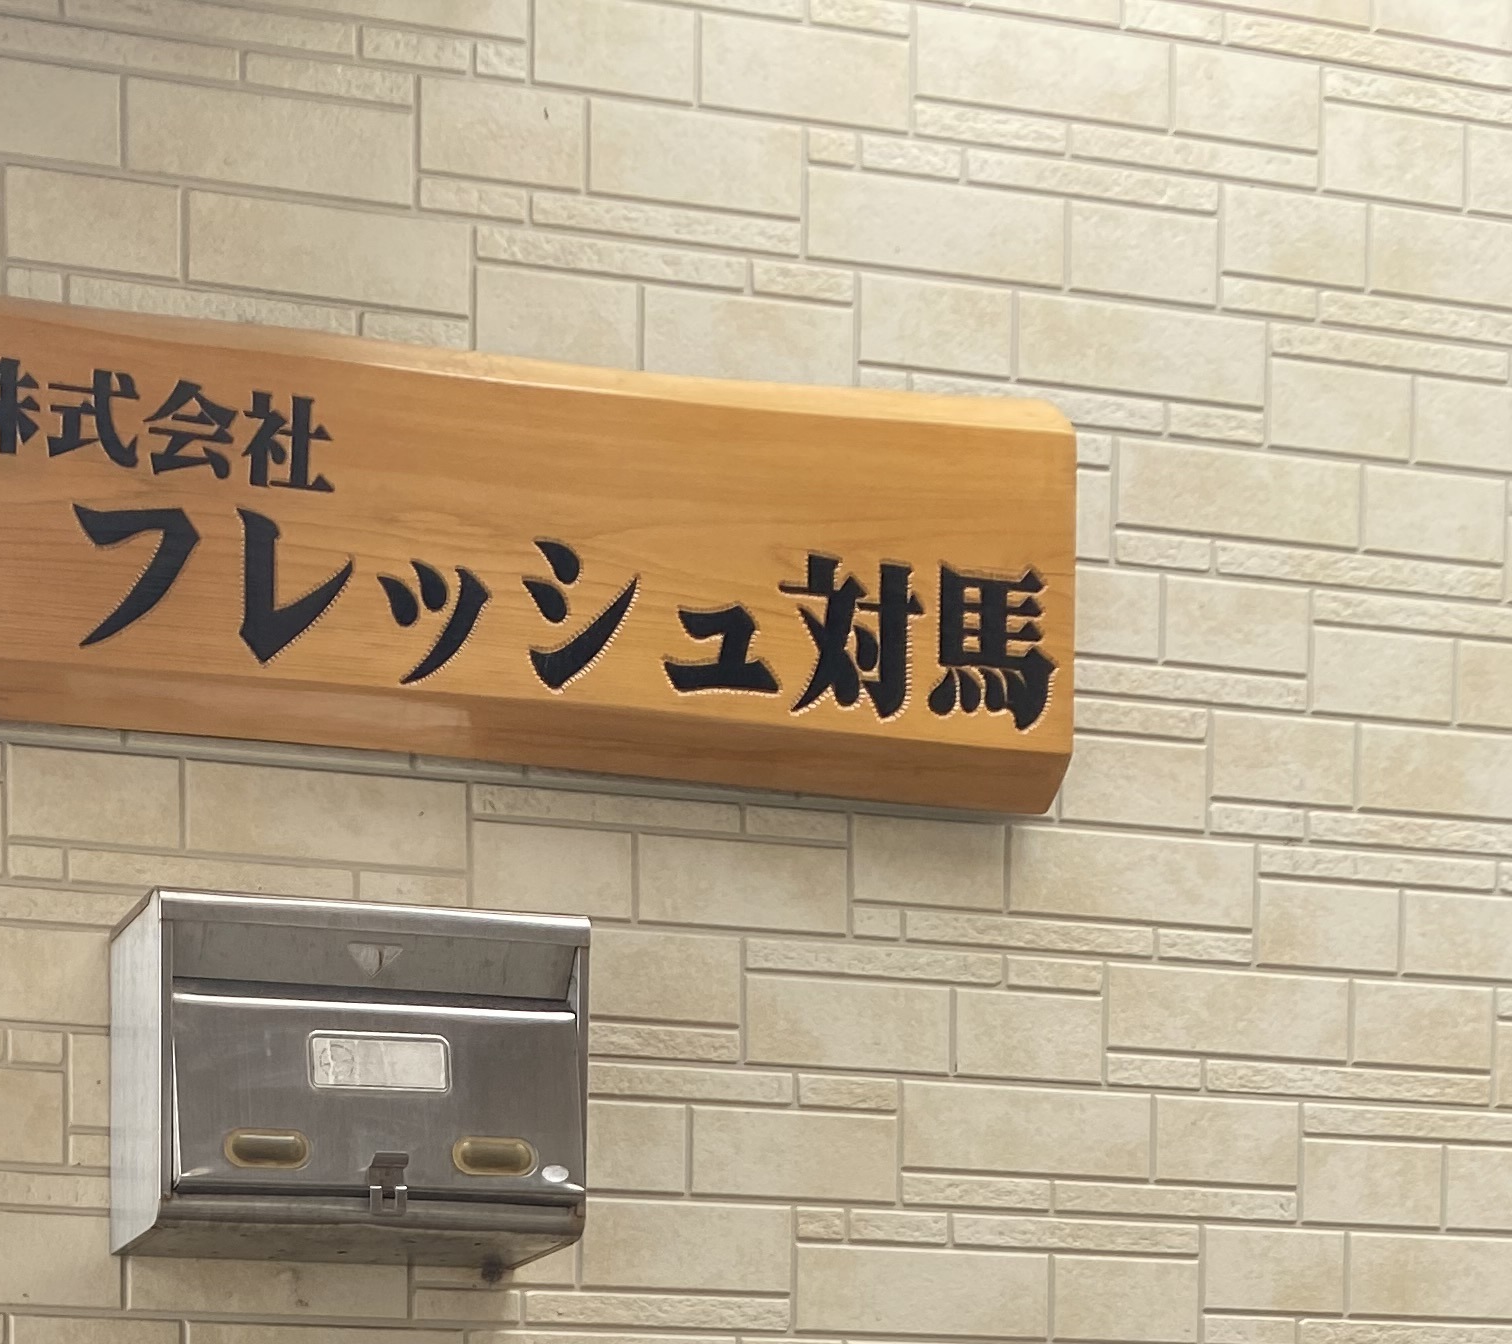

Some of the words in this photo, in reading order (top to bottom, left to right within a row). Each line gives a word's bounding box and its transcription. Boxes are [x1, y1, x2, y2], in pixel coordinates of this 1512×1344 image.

[72, 503, 1059, 732] フレッシュ対馬
